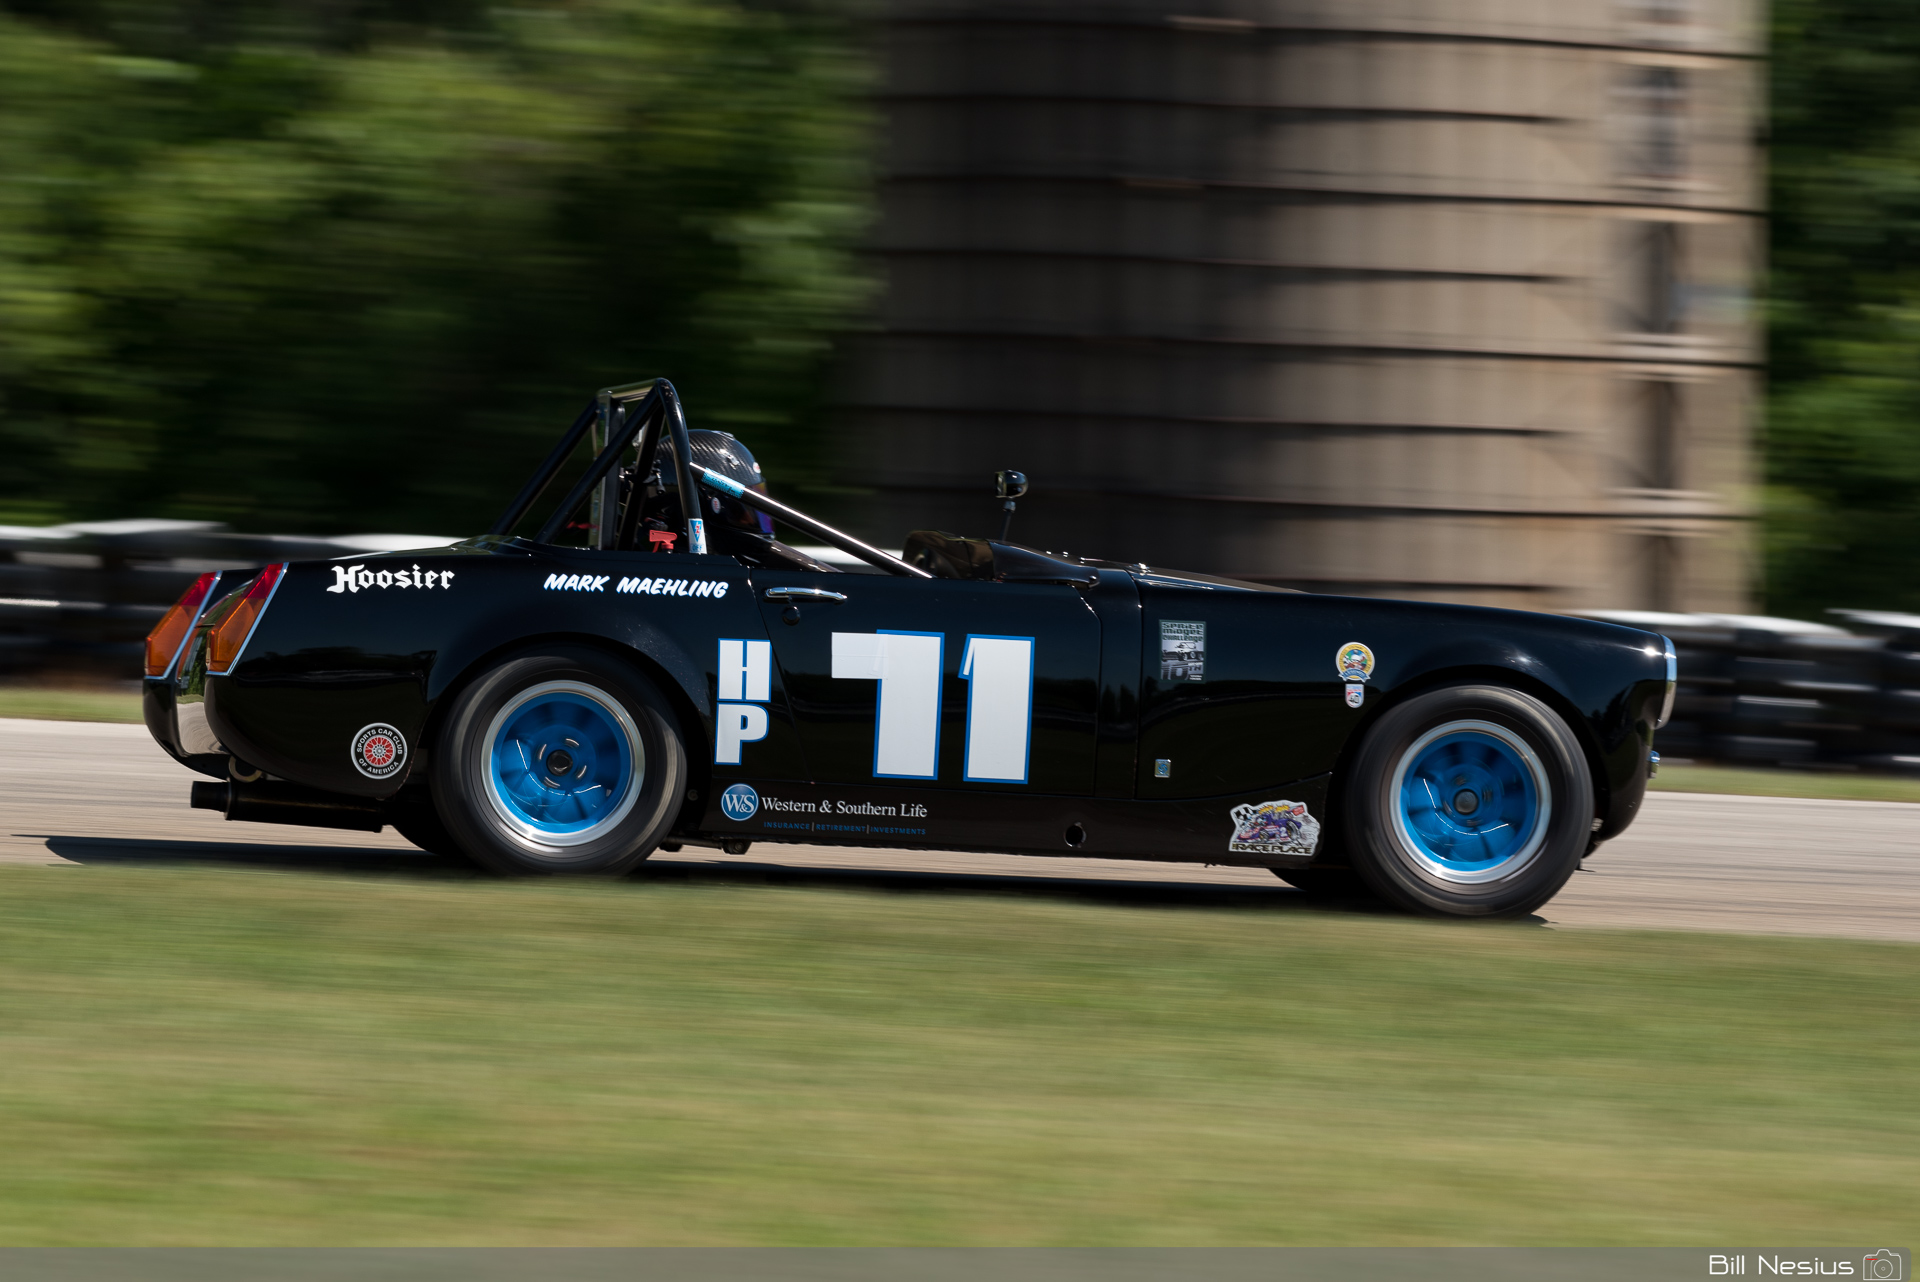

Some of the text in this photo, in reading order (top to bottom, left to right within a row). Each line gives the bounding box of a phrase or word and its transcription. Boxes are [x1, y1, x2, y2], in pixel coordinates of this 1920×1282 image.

[326, 564, 455, 594] Hoosier
[543, 573, 729, 598] MARK MAEHLING
[831, 629, 1035, 785] 71
[357, 728, 403, 755] SPORTS CAR CLUB
[358, 758, 399, 774] OF AMERICA
[761, 797, 928, 818] Western & Southern Life
[763, 821, 926, 835] INSURANCE RETIREMENT INVESTMENTS
[1236, 843, 1269, 852] RACE
[1271, 845, 1312, 855] PLACE
